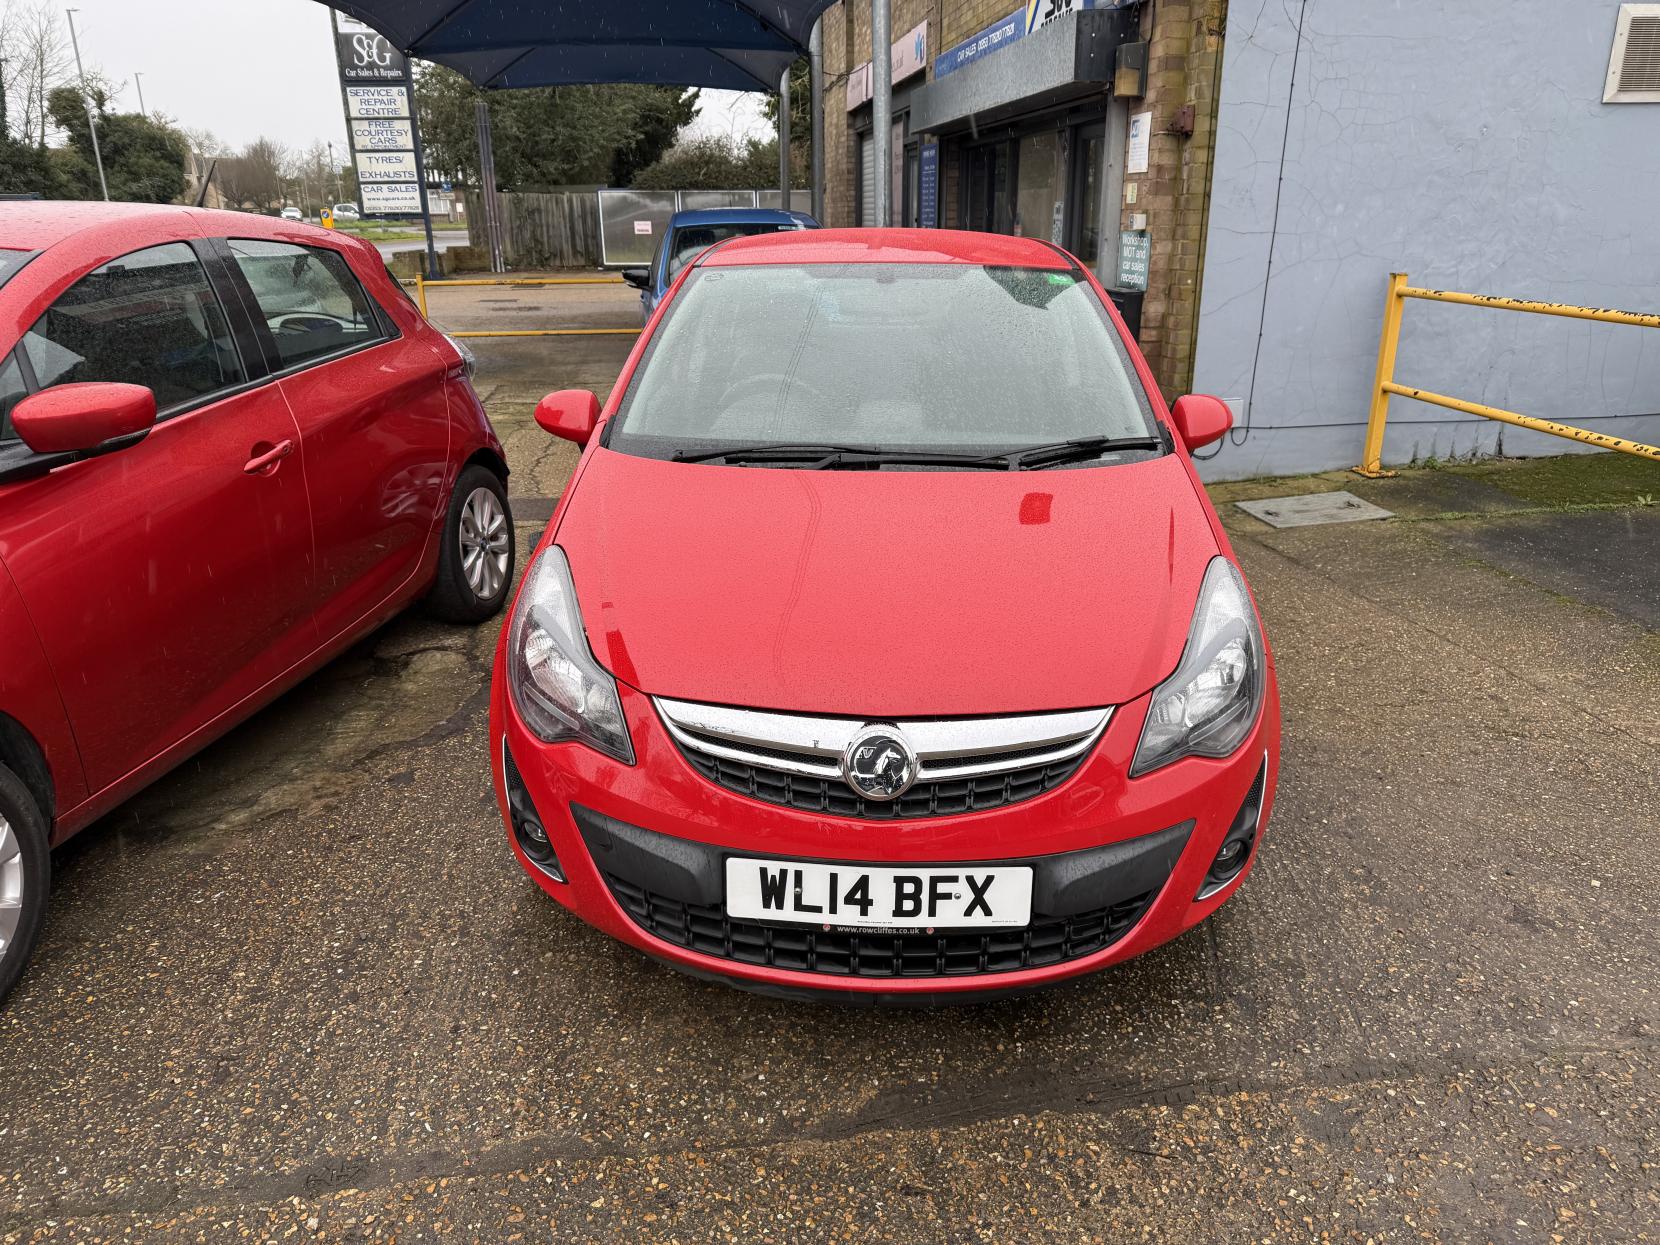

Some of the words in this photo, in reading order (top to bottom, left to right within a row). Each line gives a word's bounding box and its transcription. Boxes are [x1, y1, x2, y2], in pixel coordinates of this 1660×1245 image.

[352, 34, 392, 66] S&G
[345, 68, 357, 76] Car
[357, 68, 373, 76] Sales
[373, 68, 380, 77] &
[380, 68, 402, 79] Repairs
[349, 88, 393, 97] SERVICE
[397, 88, 405, 97] &
[359, 98, 397, 106] REPAIR
[358, 107, 401, 115] CENTRE
[368, 120, 395, 128] FREE
[360, 170, 415, 178] EXHAUSTS
[362, 185, 383, 193] CAR
[386, 185, 418, 193] SALES
[1136, 248, 1146, 259] and
[1131, 260, 1145, 272] sales
[1121, 272, 1145, 285] reception
[759, 866, 874, 917] WL14
[892, 874, 996, 918] BFX
[836, 926, 920, 935] www.rowcliffes.co.uk
